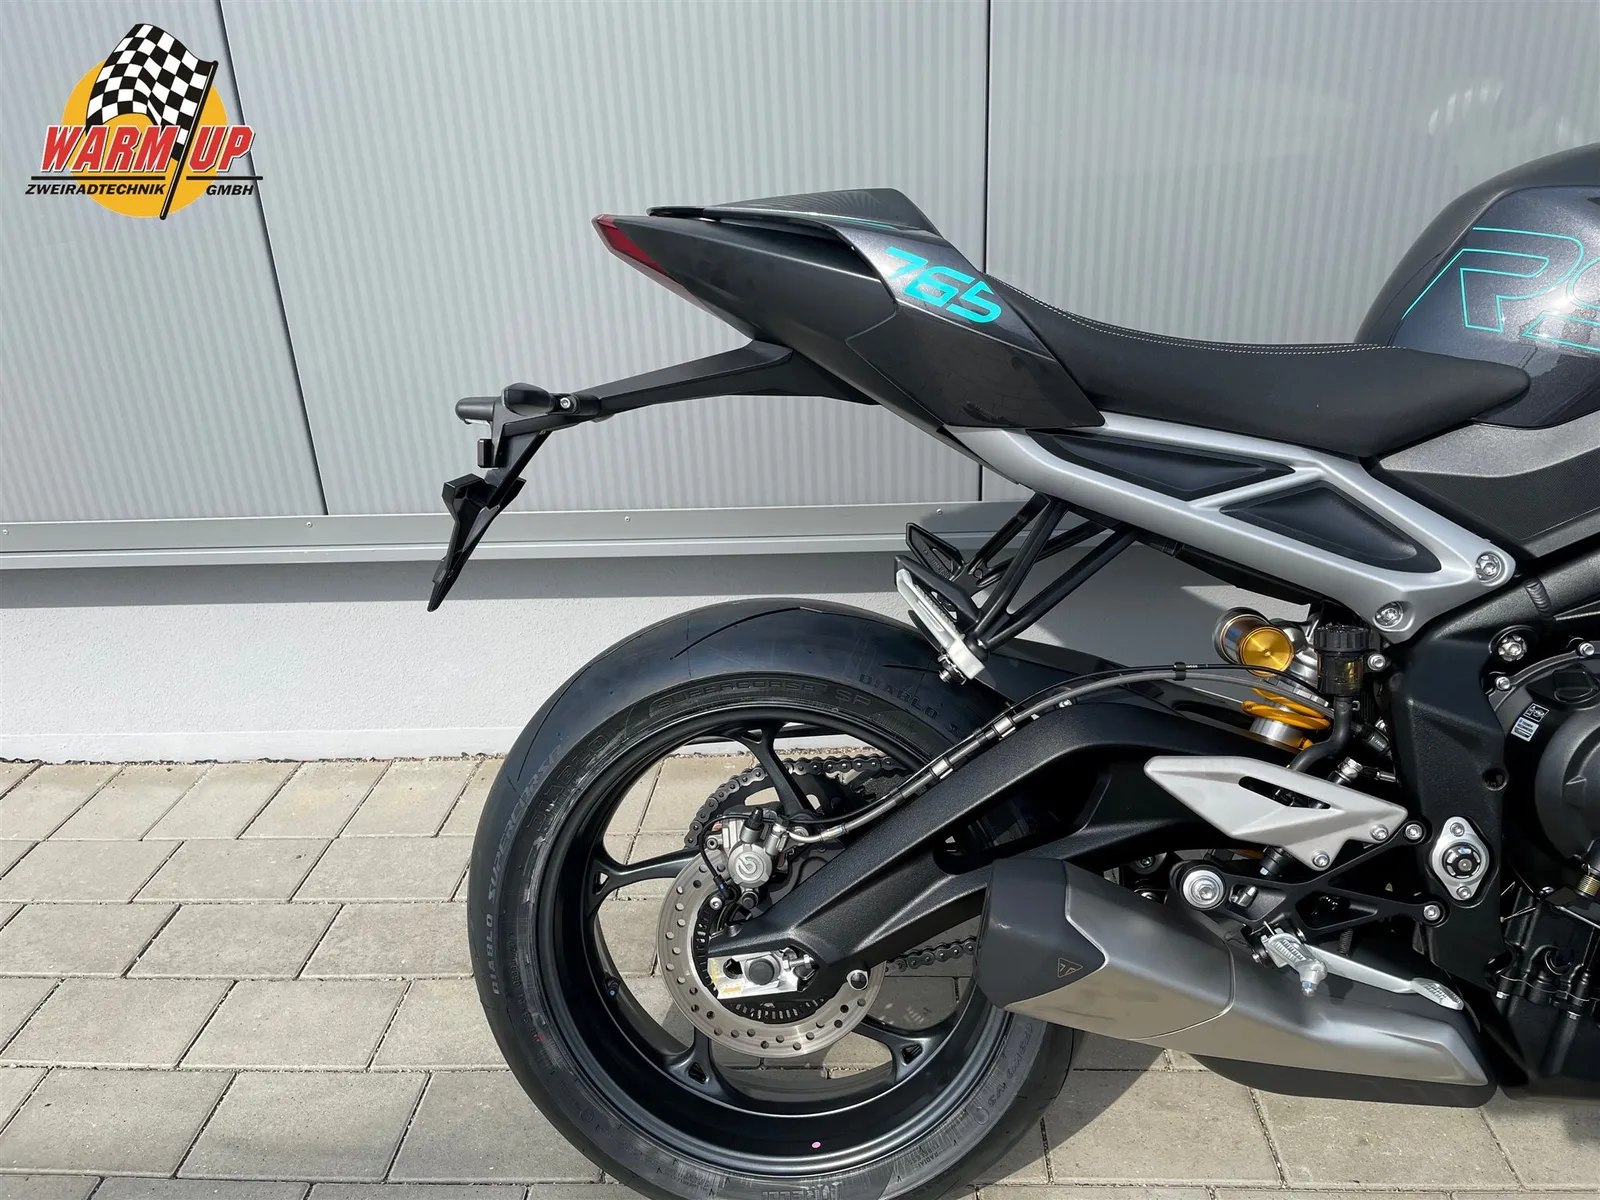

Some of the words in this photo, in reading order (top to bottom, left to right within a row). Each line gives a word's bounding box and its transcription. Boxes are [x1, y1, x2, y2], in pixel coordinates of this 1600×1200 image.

[885, 246, 1001, 323] 765
[657, 680, 817, 709] SUPERCORSA
[834, 689, 873, 706] SP
[486, 913, 500, 995] DIABLO
